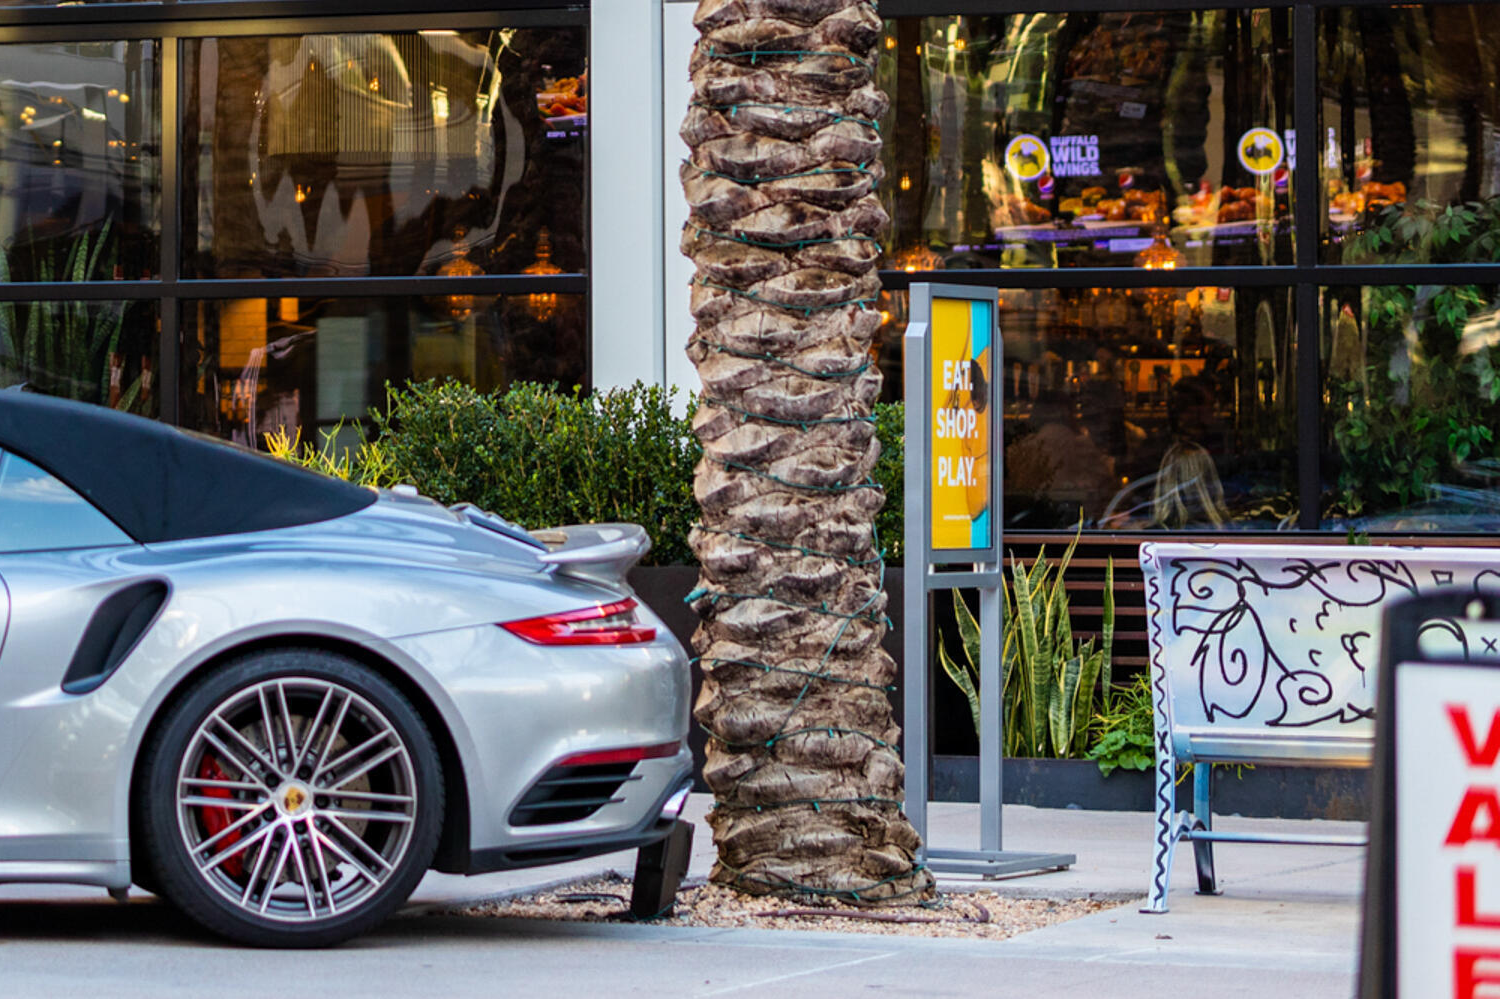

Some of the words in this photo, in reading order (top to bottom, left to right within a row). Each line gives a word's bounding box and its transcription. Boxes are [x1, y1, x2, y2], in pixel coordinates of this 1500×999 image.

[1050, 135, 1099, 147] BUFFALO
[1052, 146, 1100, 163] WILD
[943, 360, 974, 391] EAT.
[936, 408, 978, 439] SHOP.
[938, 456, 977, 487] PLAY.
